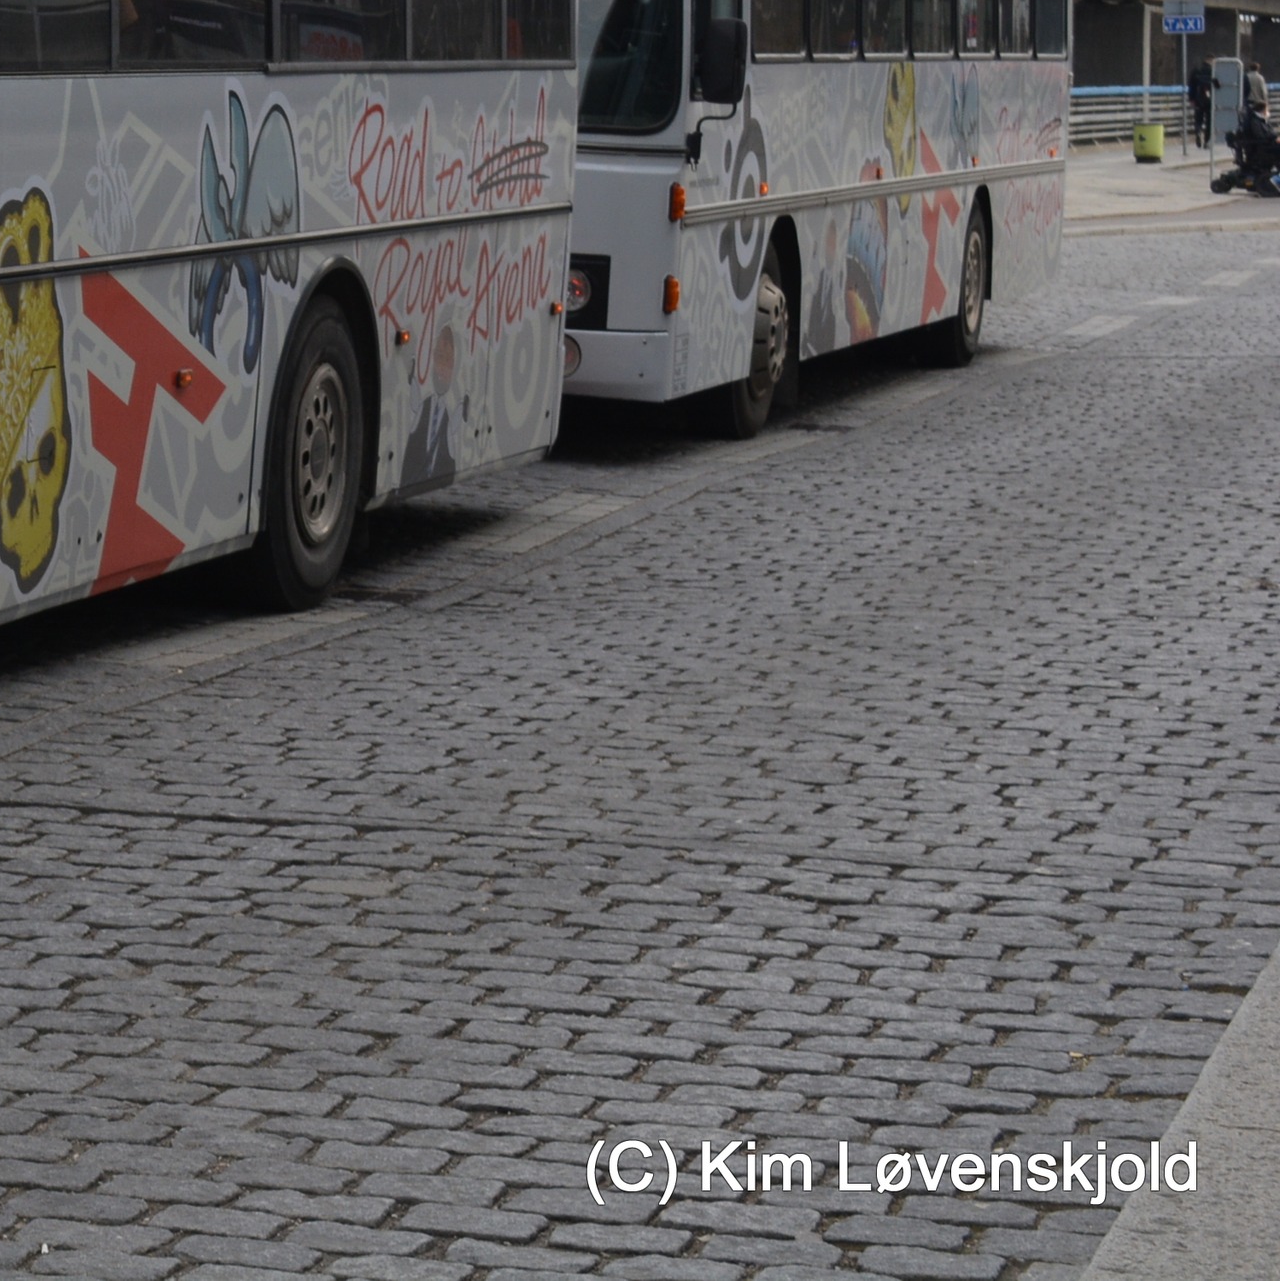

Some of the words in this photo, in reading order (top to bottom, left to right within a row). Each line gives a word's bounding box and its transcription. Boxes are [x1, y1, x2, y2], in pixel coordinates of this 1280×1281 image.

[1166, 18, 1201, 31] TAXI
[348, 97, 429, 225] Road
[436, 154, 463, 215] to
[374, 213, 470, 385] Royal
[467, 231, 551, 355] Arena
